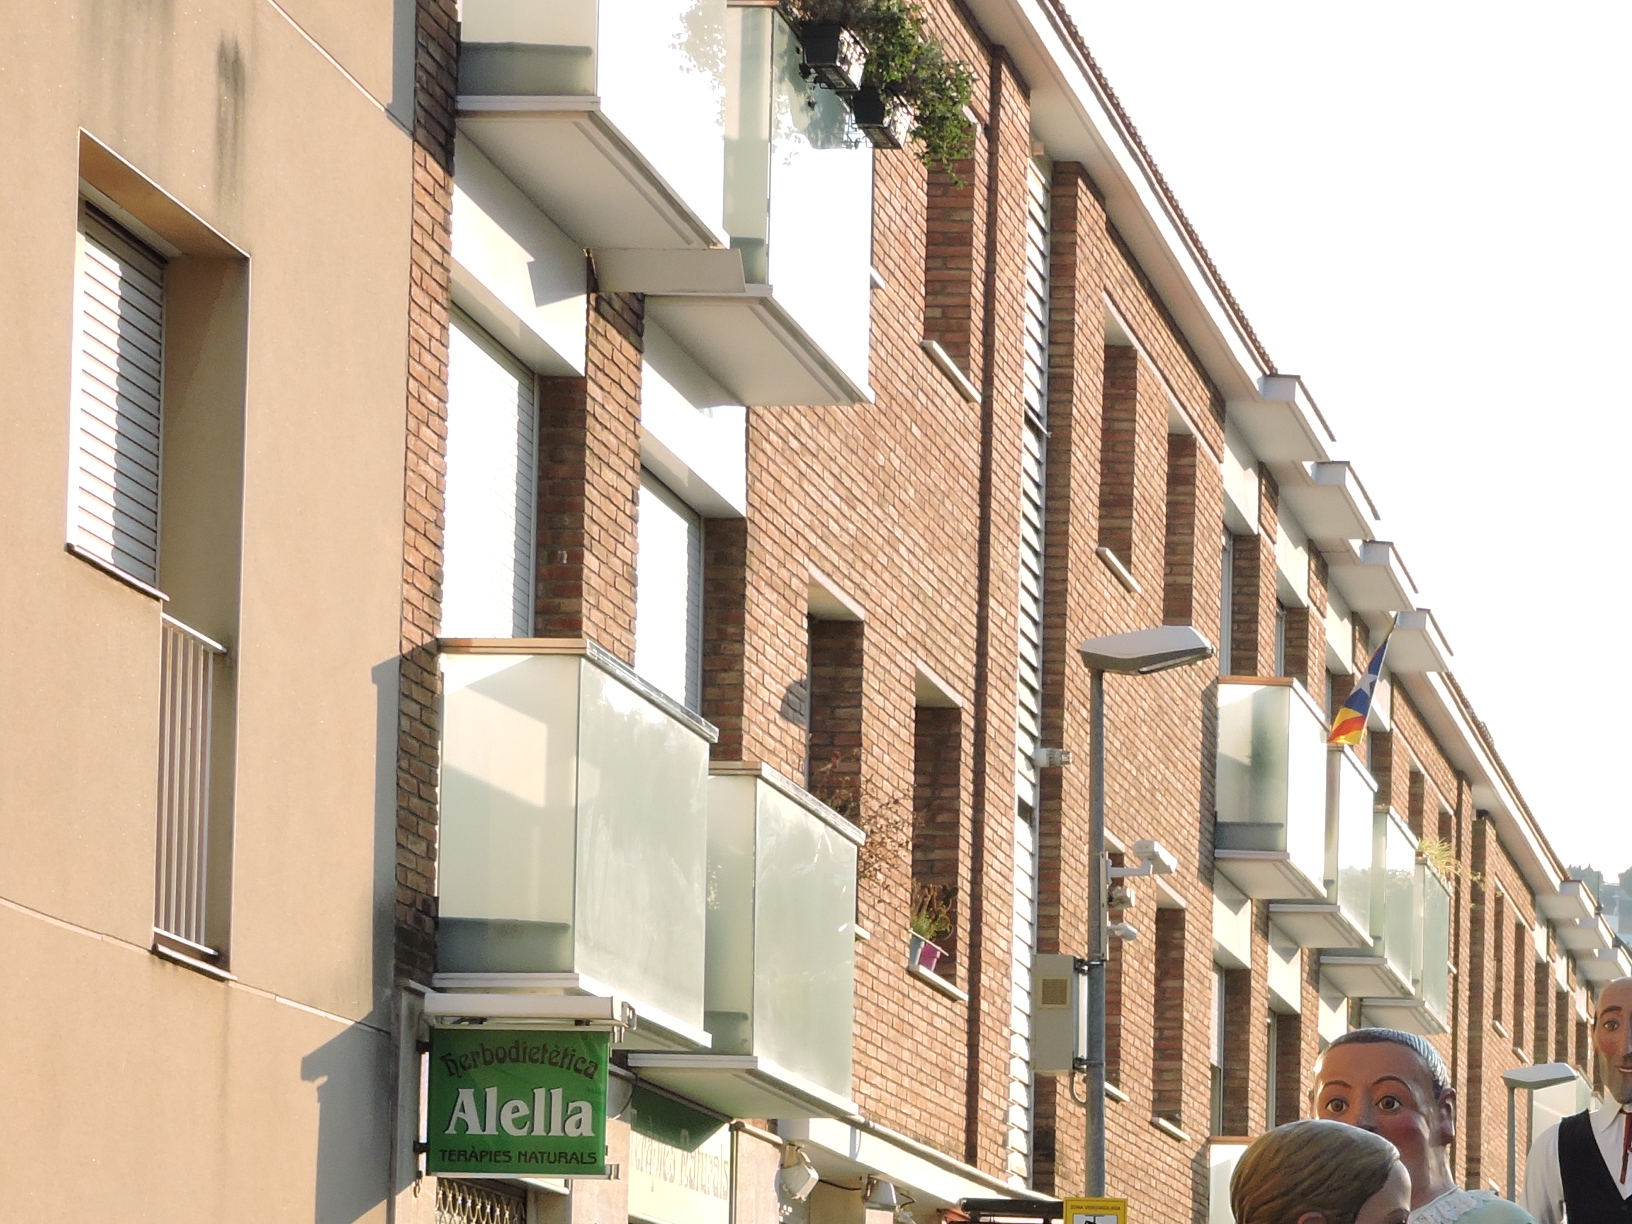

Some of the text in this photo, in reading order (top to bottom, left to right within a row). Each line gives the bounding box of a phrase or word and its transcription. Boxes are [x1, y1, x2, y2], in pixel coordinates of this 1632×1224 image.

[444, 1086, 595, 1137] Alella
[439, 1145, 597, 1165] TERÀPIES NATURALS
